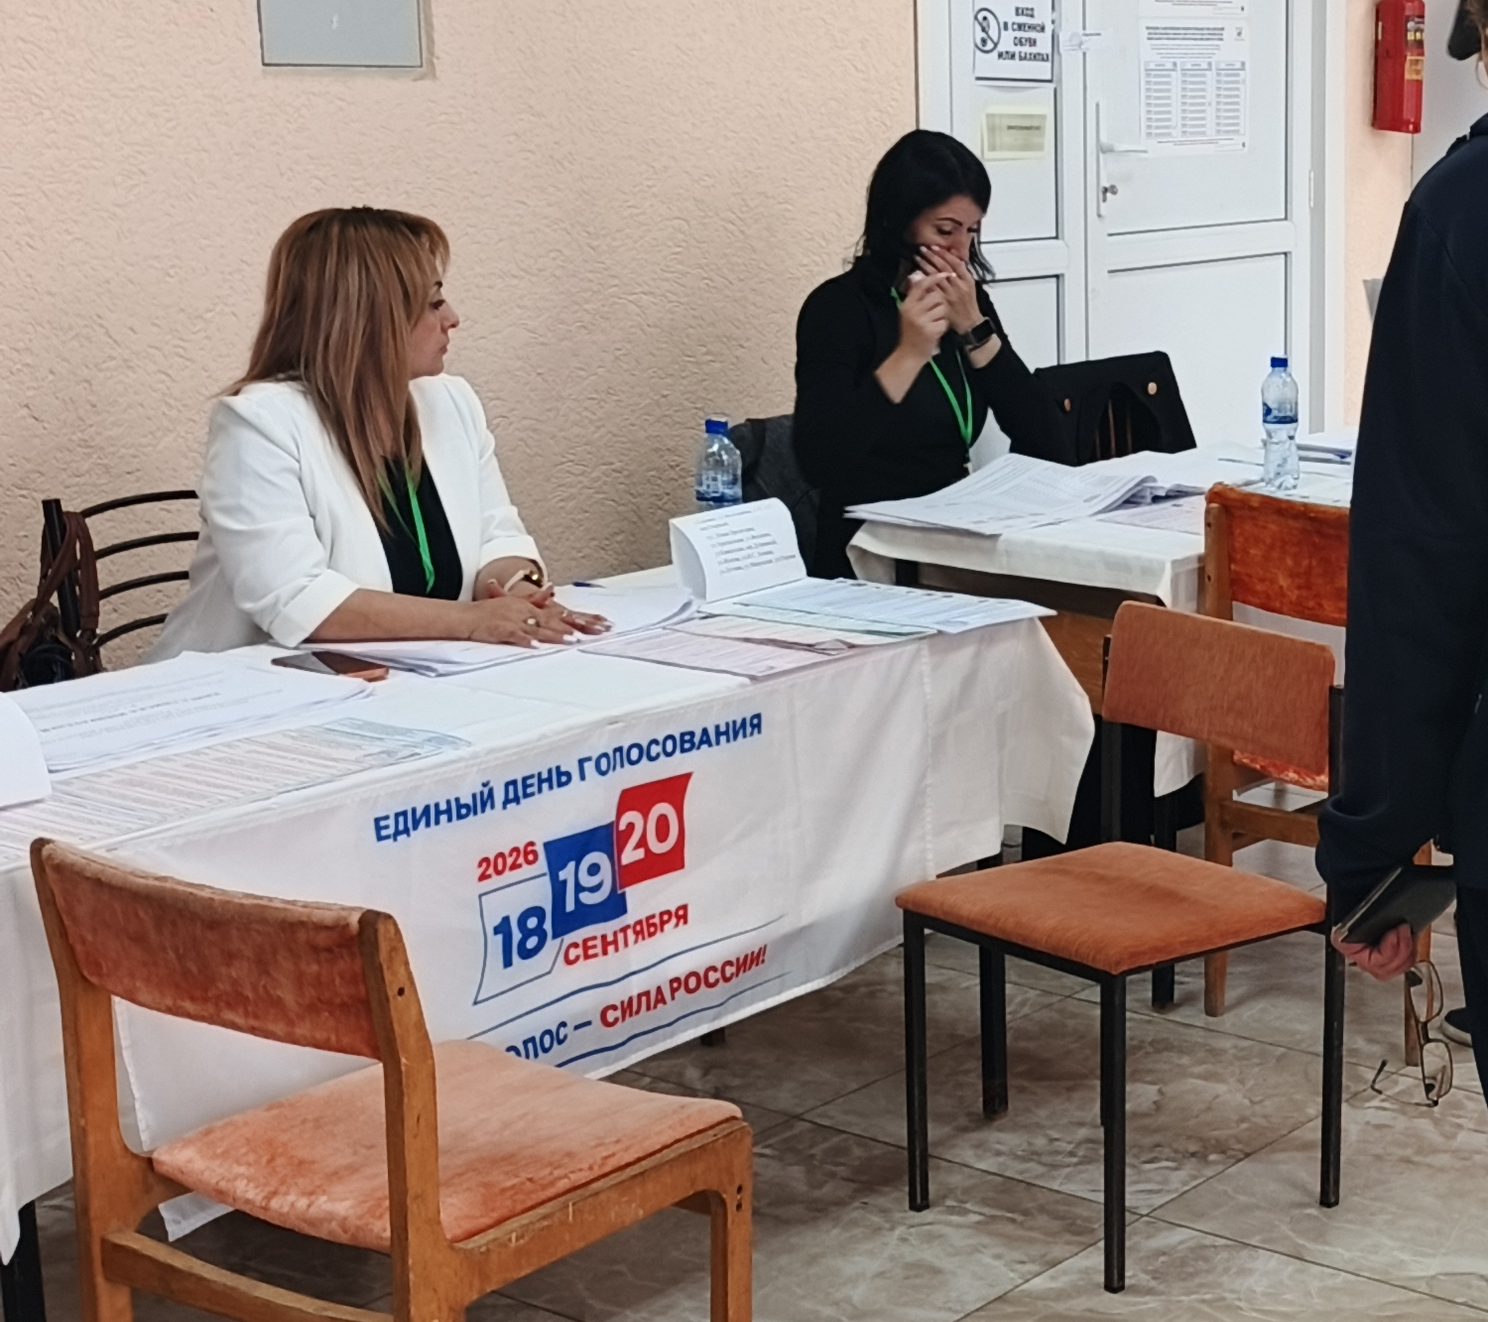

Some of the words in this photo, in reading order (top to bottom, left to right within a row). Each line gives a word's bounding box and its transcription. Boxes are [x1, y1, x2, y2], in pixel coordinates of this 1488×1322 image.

[1003, 21, 1009, 31] В
[1011, 21, 1046, 33] СМЕННОЙ
[1013, 36, 1037, 47] ОБУВИ
[1015, 6, 1035, 18] ВХОД
[997, 50, 1016, 60] ИЛИ
[1018, 51, 1049, 62] БАХИЛАХ
[374, 780, 495, 843] ЕДИНЫЙ
[501, 764, 572, 810] ДЕНЬ
[578, 712, 763, 782] ГОЛОСОВАНИЯ
[476, 840, 539, 883] 2026
[618, 801, 680, 866] 20
[558, 850, 613, 914] 19
[492, 905, 548, 970] 18
[563, 903, 689, 967] СЕНТЯБРЯ
[599, 986, 667, 1029] СИЛА
[668, 943, 768, 1001] РОССИИ!
